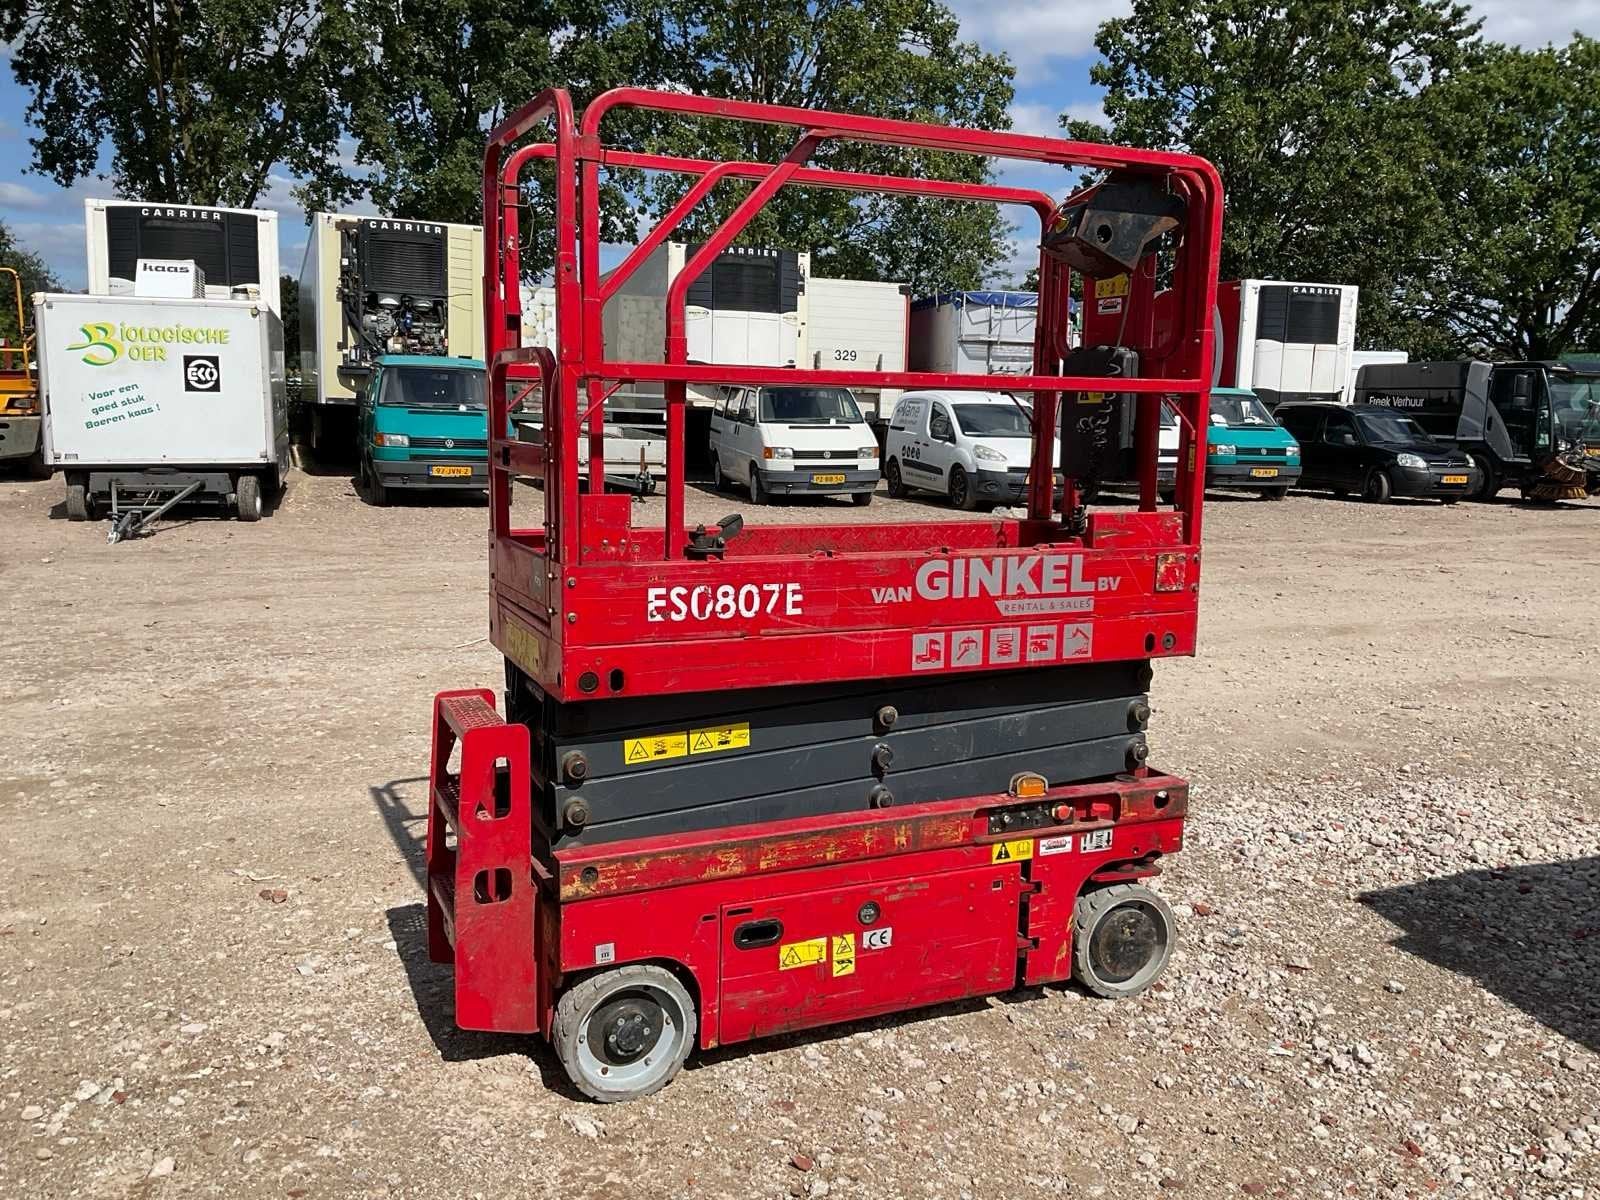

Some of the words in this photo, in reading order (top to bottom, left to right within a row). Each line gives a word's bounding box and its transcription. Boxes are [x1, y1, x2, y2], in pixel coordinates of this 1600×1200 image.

[141, 208, 222, 220] CARRIER
[369, 221, 442, 234] CARRIER
[143, 262, 190, 273] kaas
[1292, 286, 1340, 295] CARRIER
[834, 349, 857, 362] 329
[88, 389, 116, 402] Voor
[118, 383, 140, 394] een
[91, 400, 119, 416] goed
[121, 393, 146, 408] stuk
[1392, 395, 1425, 407] Verhuur
[85, 414, 126, 430] Boeren
[128, 406, 154, 419] kaas
[871, 586, 912, 604] VAN
[915, 554, 1095, 601] GINKEL
[1098, 576, 1121, 591] BV
[1003, 601, 1046, 614] RENTAL
[1059, 600, 1091, 610] SALES
[869, 930, 888, 947] CE
